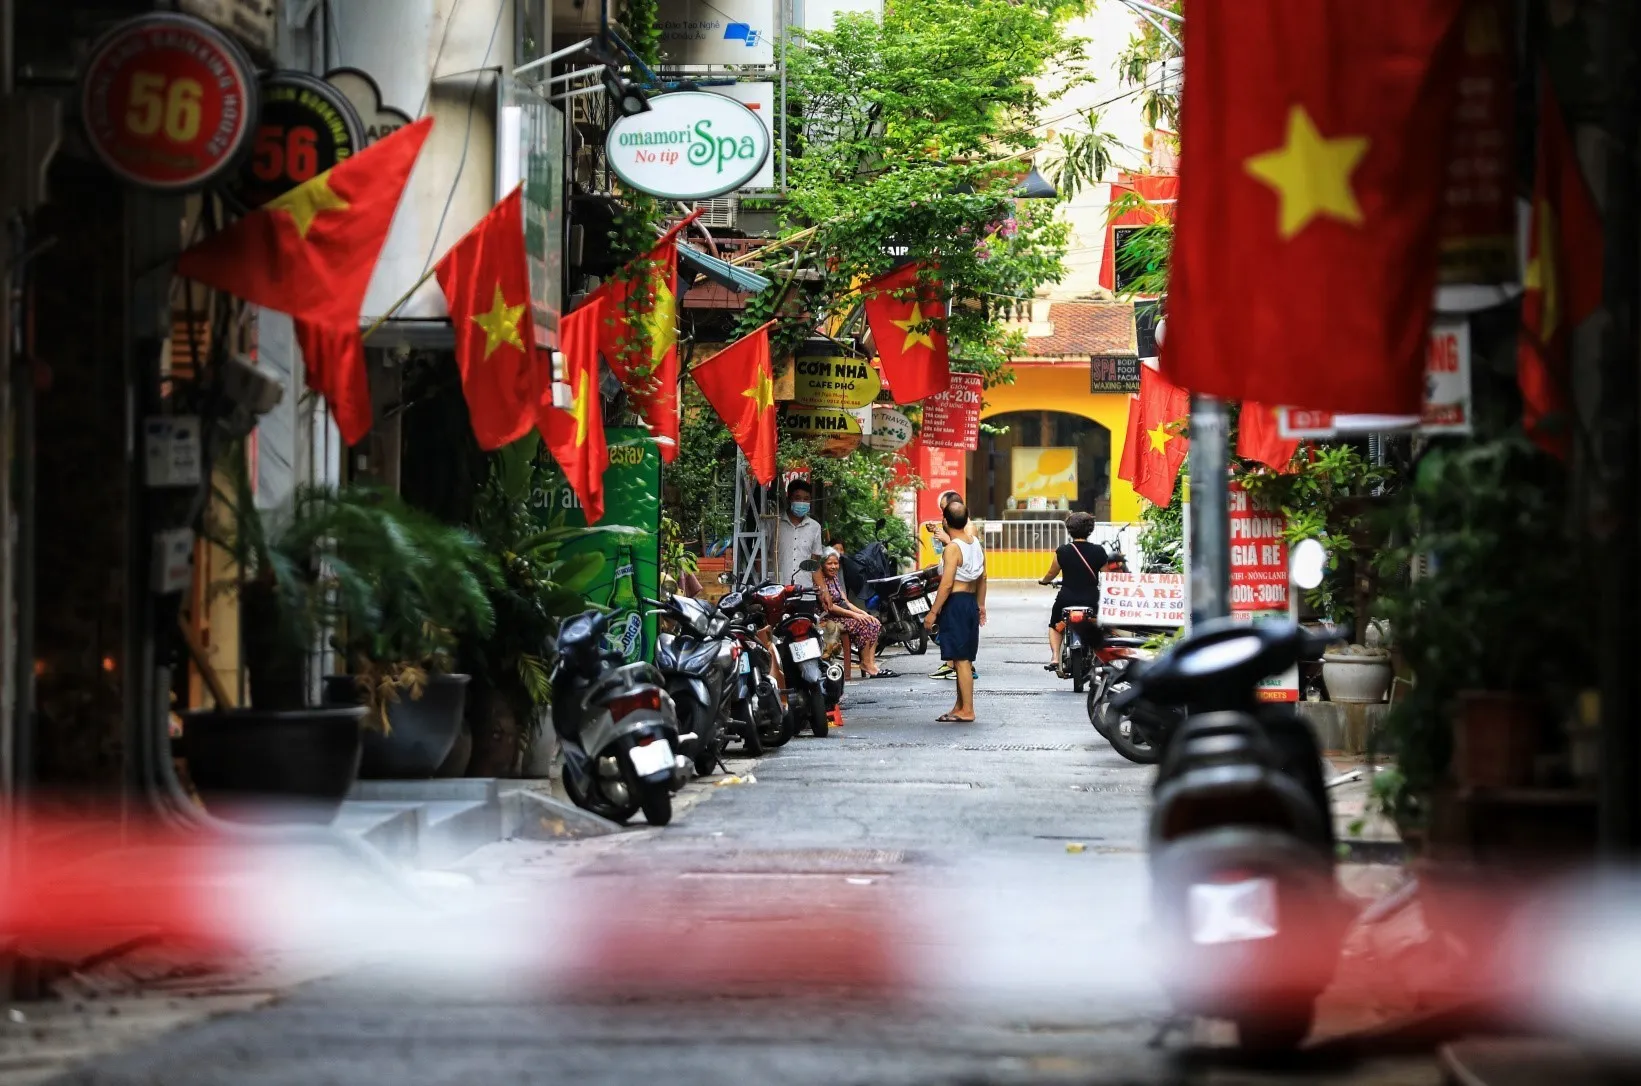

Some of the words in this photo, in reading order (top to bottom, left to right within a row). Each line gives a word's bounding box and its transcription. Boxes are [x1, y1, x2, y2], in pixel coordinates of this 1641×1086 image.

[125, 72, 203, 143] 56
[252, 124, 318, 183] 56
[618, 124, 691, 146] omamori
[687, 119, 755, 174] Spa
[635, 150, 656, 163] No
[660, 149, 679, 165] tip
[797, 360, 832, 377] CƠM
[834, 362, 868, 380] NHÀ
[1093, 359, 1117, 381] SPA
[808, 380, 833, 389] CAFE
[1093, 382, 1122, 390] WAXING
[814, 413, 849, 431] NHÀ
[881, 413, 909, 428] TRAVEL
[1230, 514, 1283, 539] PHÒNG
[1231, 542, 1259, 566] GIÁ
[1139, 574, 1154, 584] XE
[1107, 584, 1146, 598] GIÁ
[1103, 597, 1116, 606] XE
[1119, 599, 1134, 608] GA
[1153, 601, 1167, 609] XE
[1119, 609, 1143, 618] 80K
